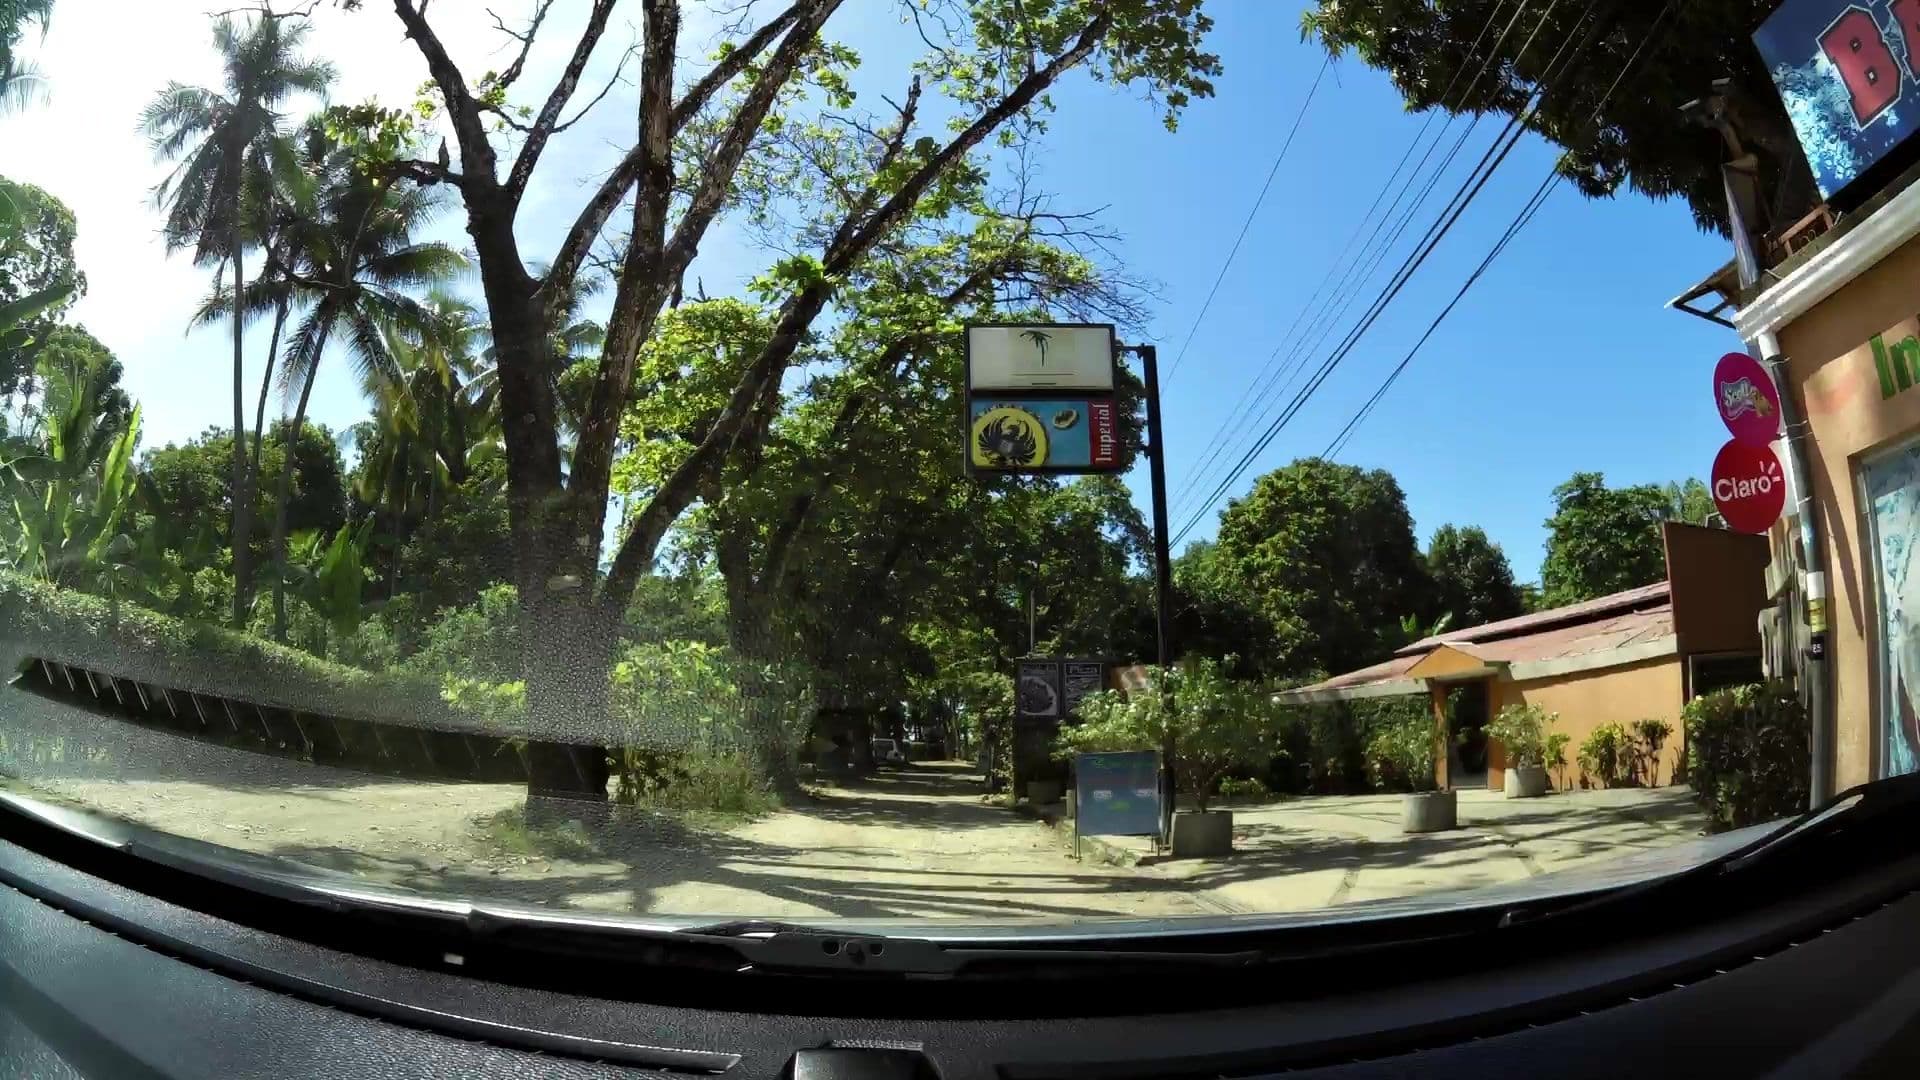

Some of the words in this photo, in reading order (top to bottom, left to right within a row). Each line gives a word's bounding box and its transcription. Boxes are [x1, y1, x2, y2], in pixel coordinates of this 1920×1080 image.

[1815, 0, 1920, 132] B
[1092, 403, 1117, 462] Imperial
[1715, 474, 1773, 502] Claro
